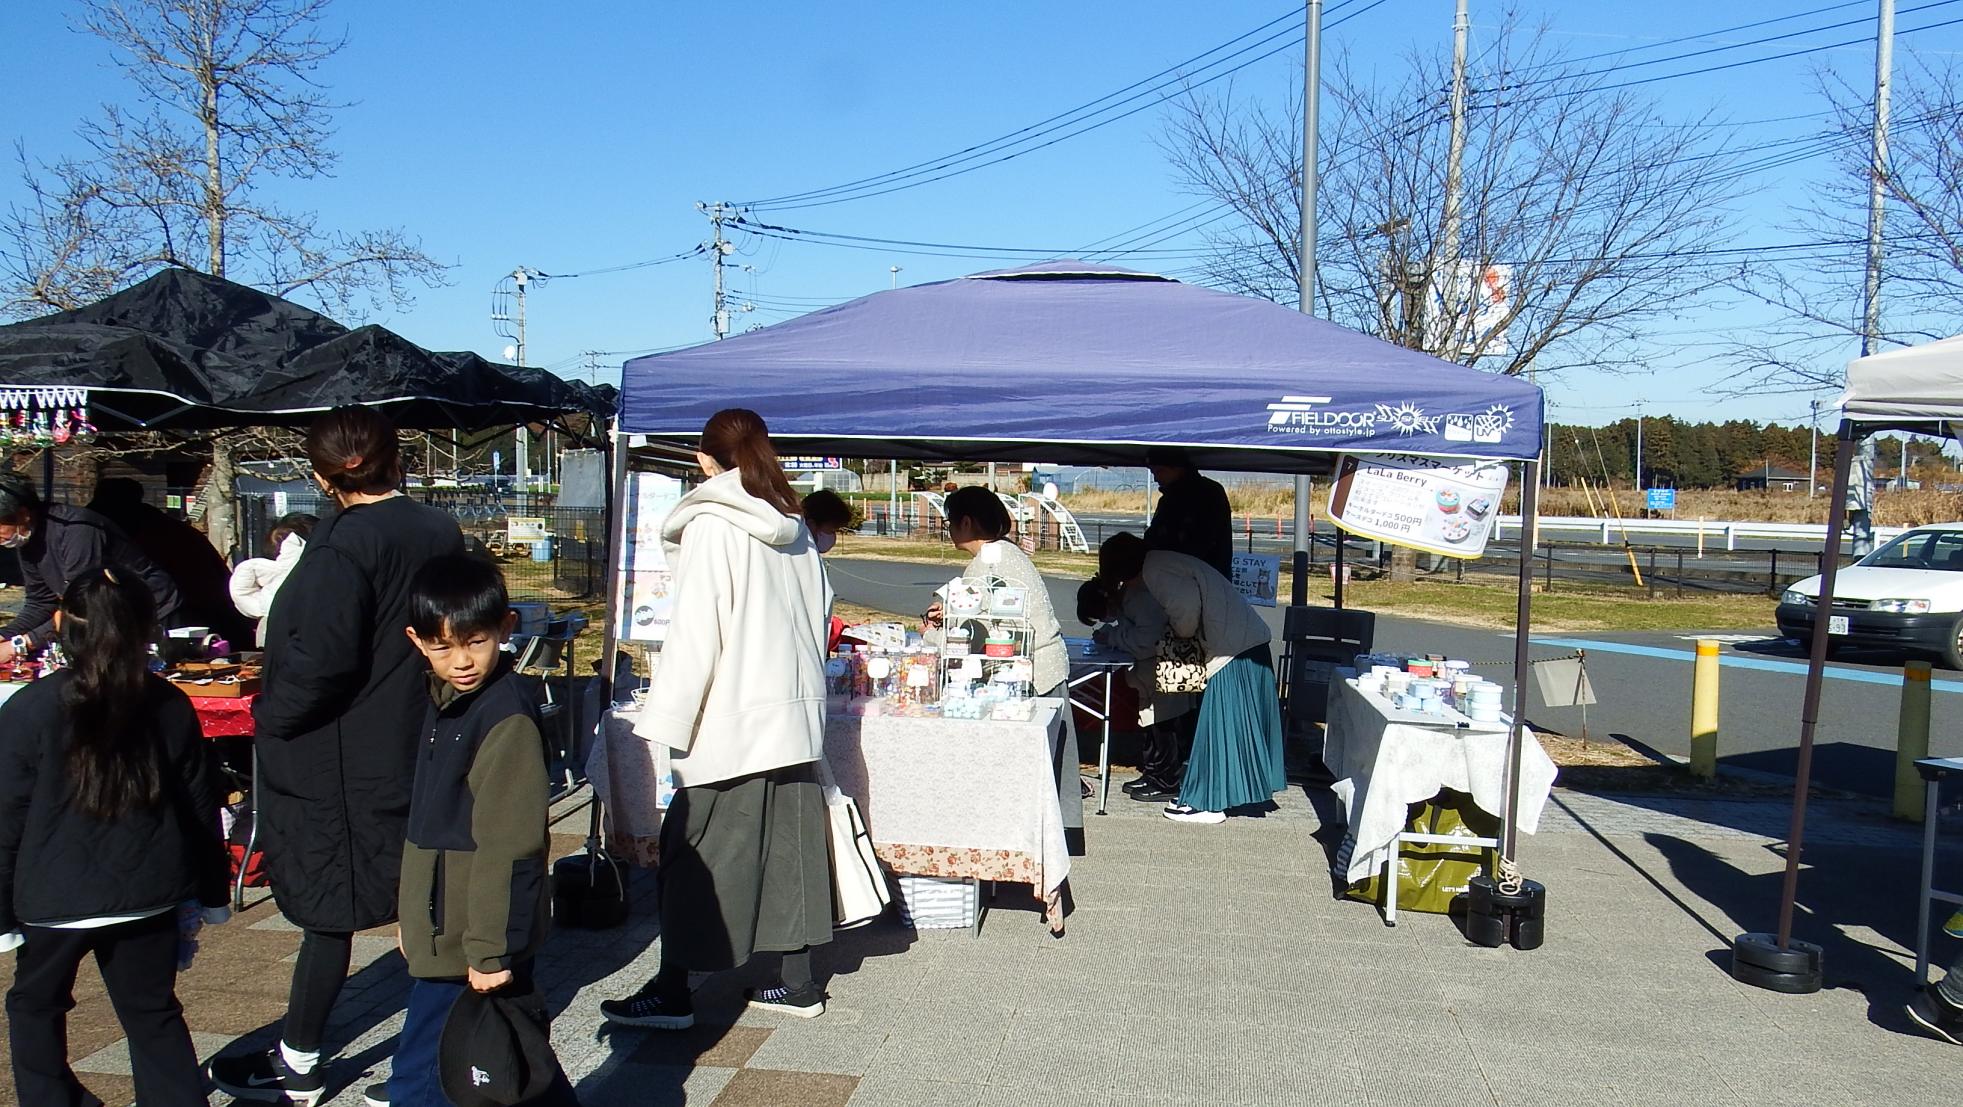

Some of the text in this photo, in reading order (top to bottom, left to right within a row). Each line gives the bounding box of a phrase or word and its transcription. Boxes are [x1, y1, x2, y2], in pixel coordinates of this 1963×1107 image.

[1291, 411, 1375, 427] FIELDOOR
[1267, 424, 1376, 438] Powered by ottostyle.jp
[1366, 466, 1428, 487] LaLa Berry
[1242, 558, 1267, 568] STAY
